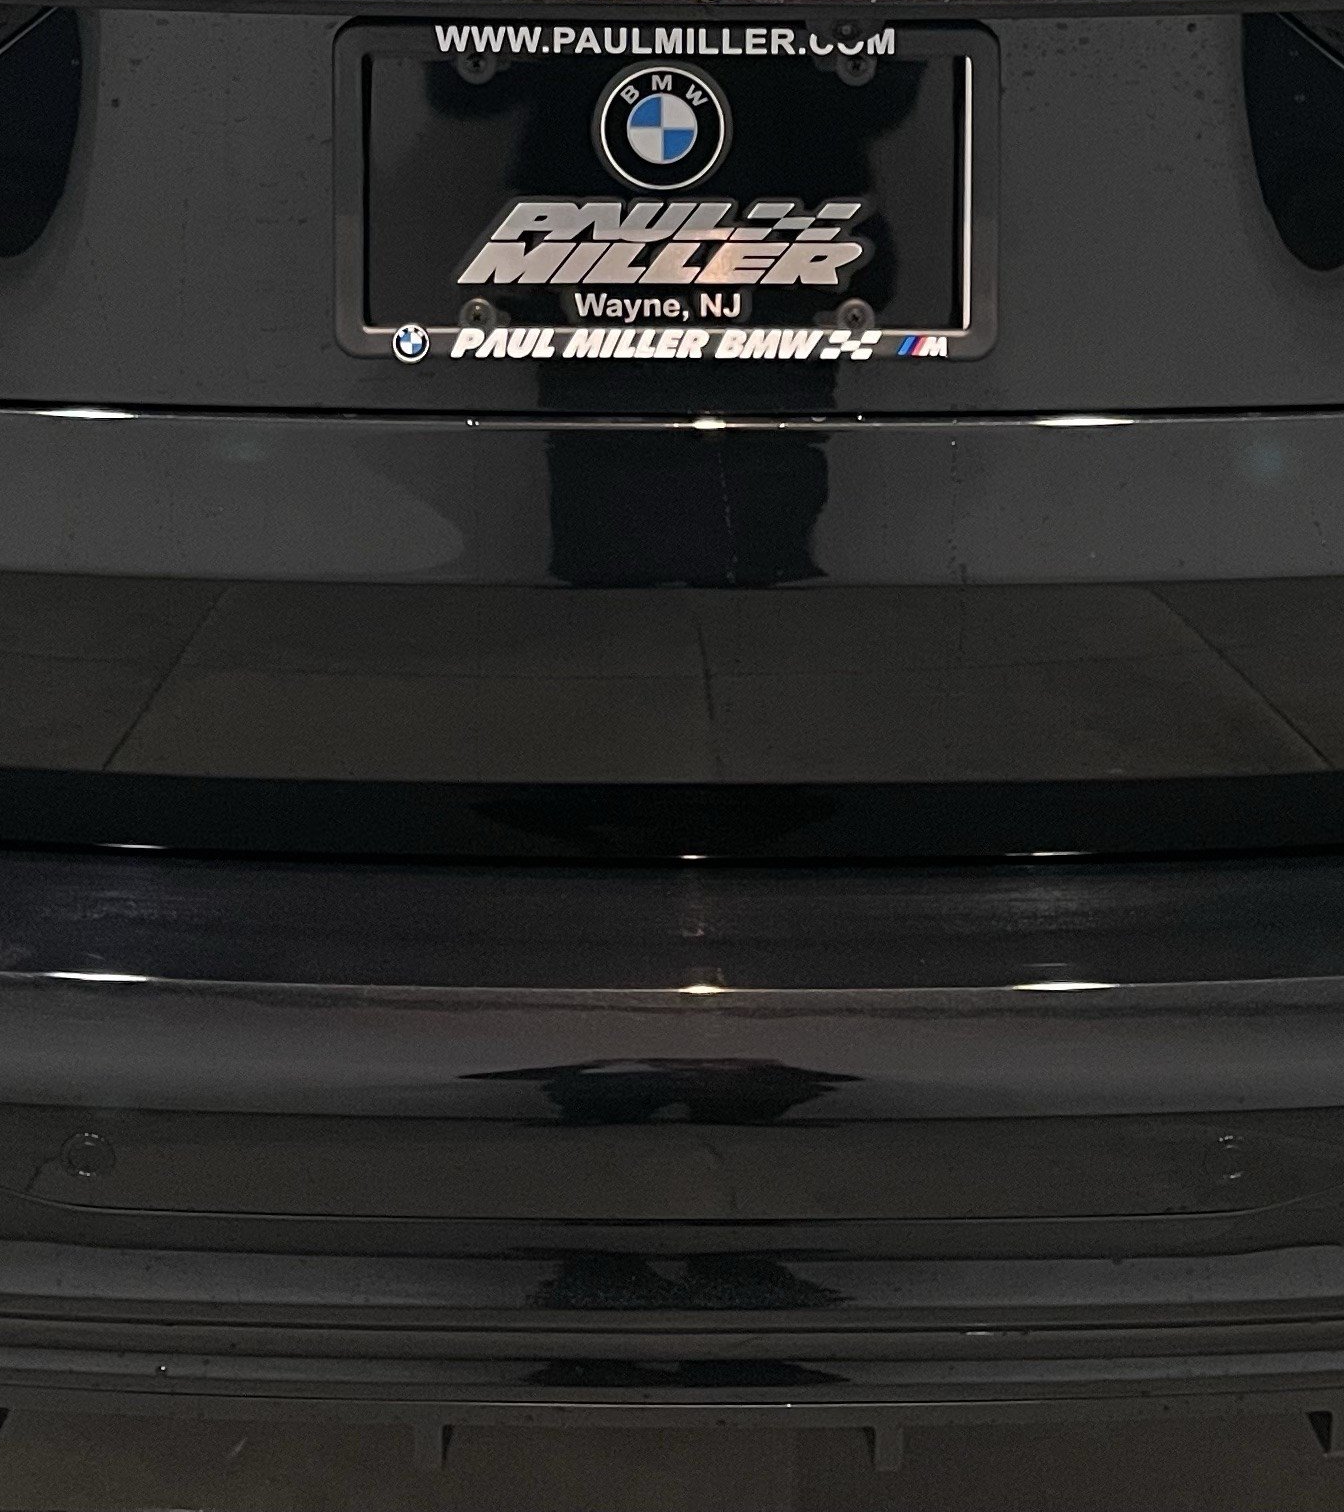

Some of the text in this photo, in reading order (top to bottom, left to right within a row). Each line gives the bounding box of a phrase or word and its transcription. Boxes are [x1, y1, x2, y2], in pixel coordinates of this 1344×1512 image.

[619, 74, 709, 107] BMW
[490, 202, 732, 242] PAUL
[457, 242, 863, 285] MILLER
[574, 293, 742, 324] Wayne, NJ
[450, 328, 824, 360] PAUL MILLER BMW
